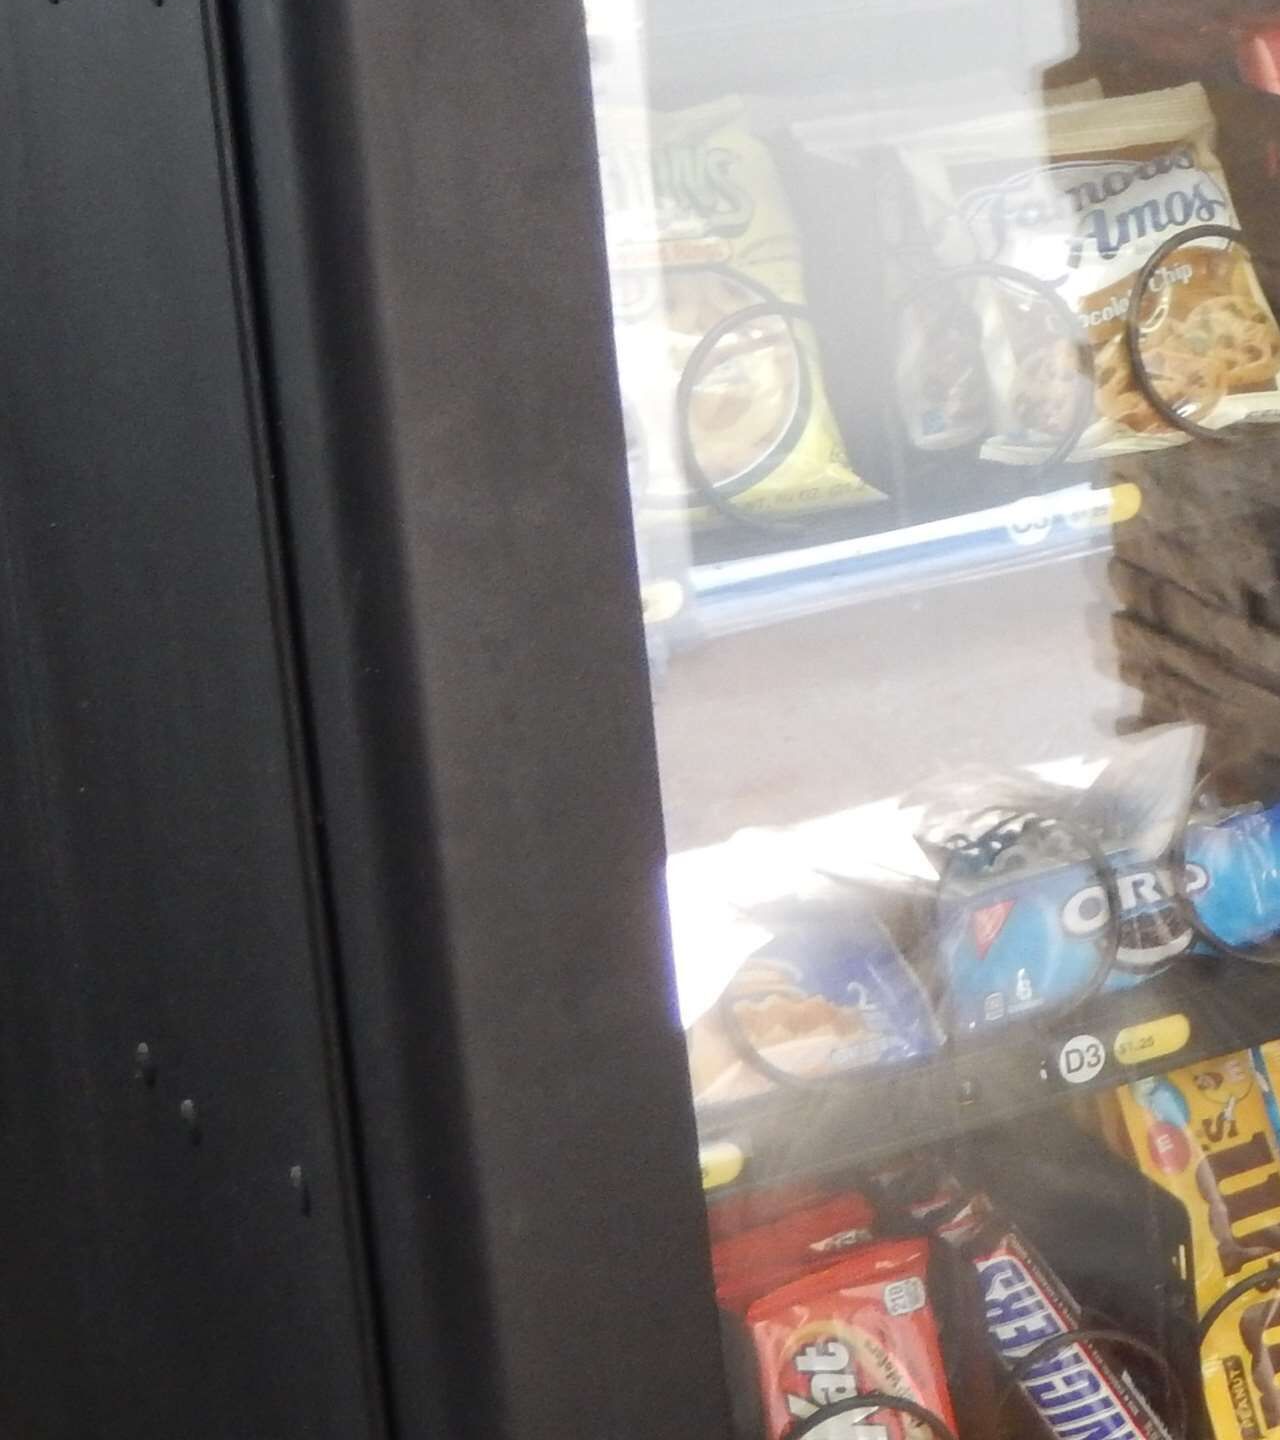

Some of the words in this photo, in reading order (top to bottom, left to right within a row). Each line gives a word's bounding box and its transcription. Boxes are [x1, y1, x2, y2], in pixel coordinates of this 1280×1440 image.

[1065, 181, 1228, 269] Amos
[1062, 863, 1210, 935] ORO
[1063, 1047, 1101, 1074] D3
